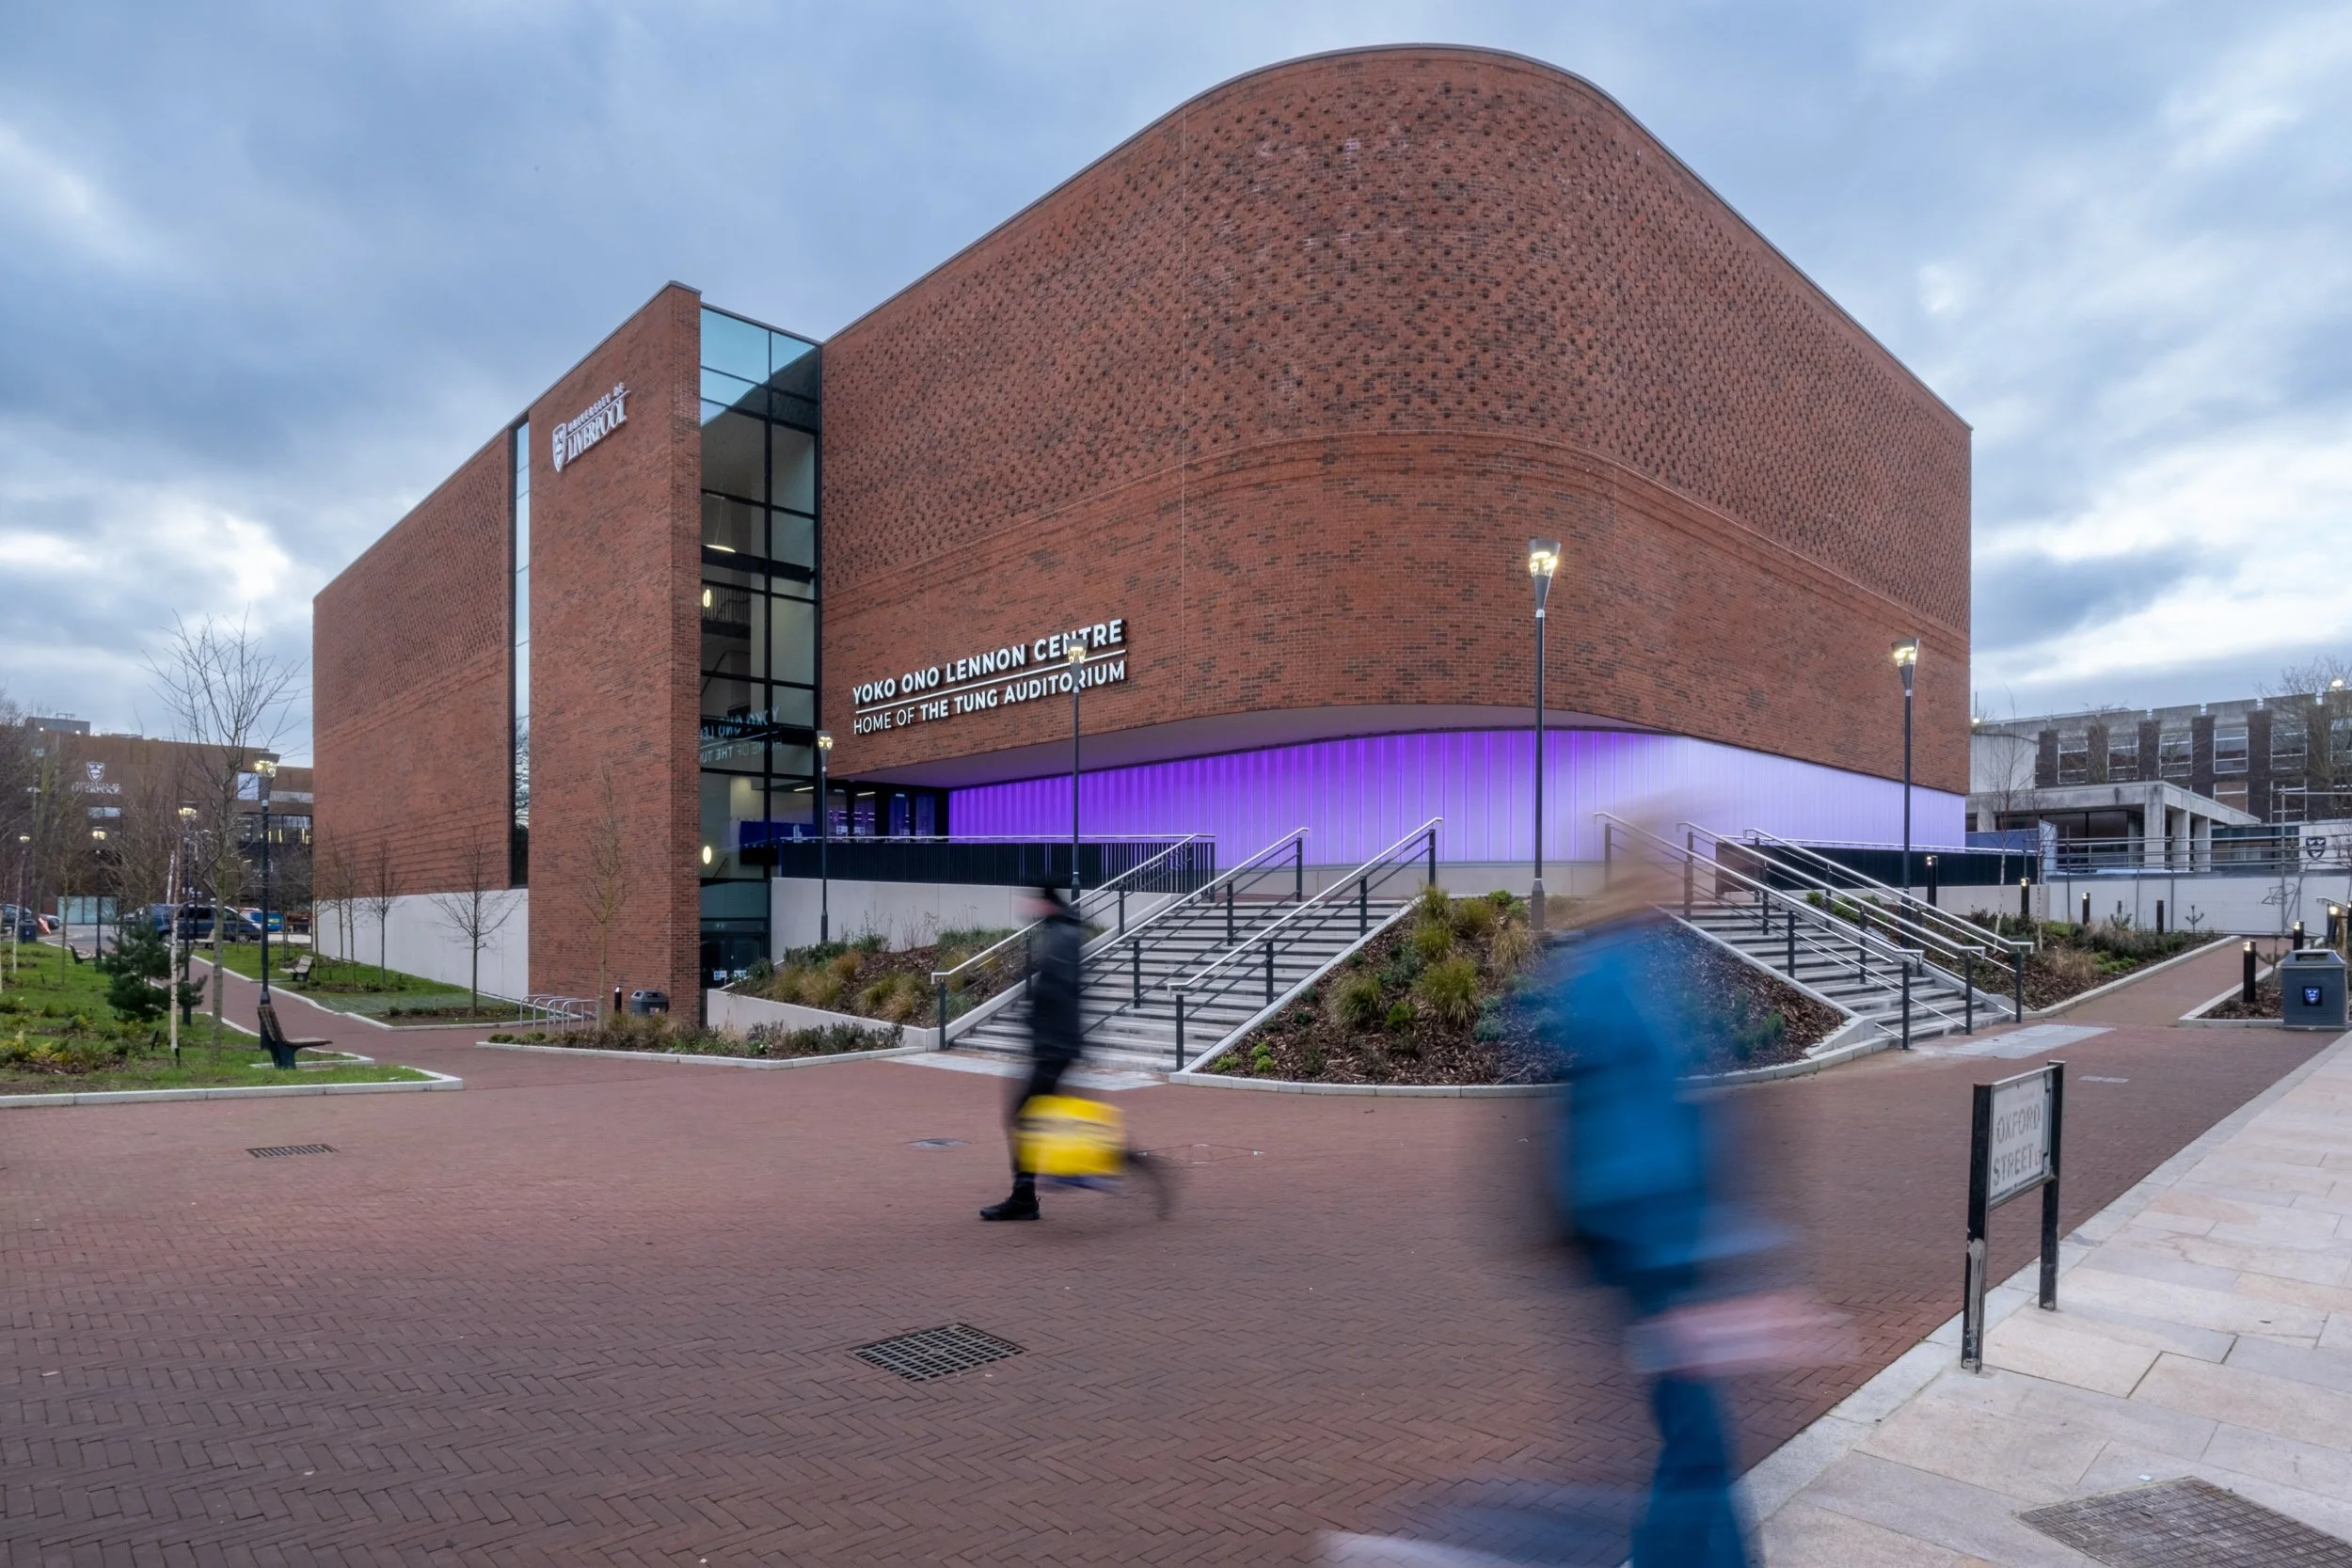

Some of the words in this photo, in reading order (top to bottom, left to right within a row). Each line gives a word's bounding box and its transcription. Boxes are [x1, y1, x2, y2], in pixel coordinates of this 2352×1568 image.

[565, 398, 628, 464] LIVERPOOL
[852, 677, 896, 705] YOKO
[901, 666, 939, 693] ONO
[946, 643, 1025, 682] LENNON
[853, 711, 892, 735] HOME
[896, 706, 915, 726] OF
[920, 699, 949, 721] THE
[954, 688, 998, 714] TUNG
[1004, 659, 1125, 705] AUDITORIUM
[1996, 1105, 2041, 1144] OXFORD
[1993, 1143, 2034, 1186] STREET
